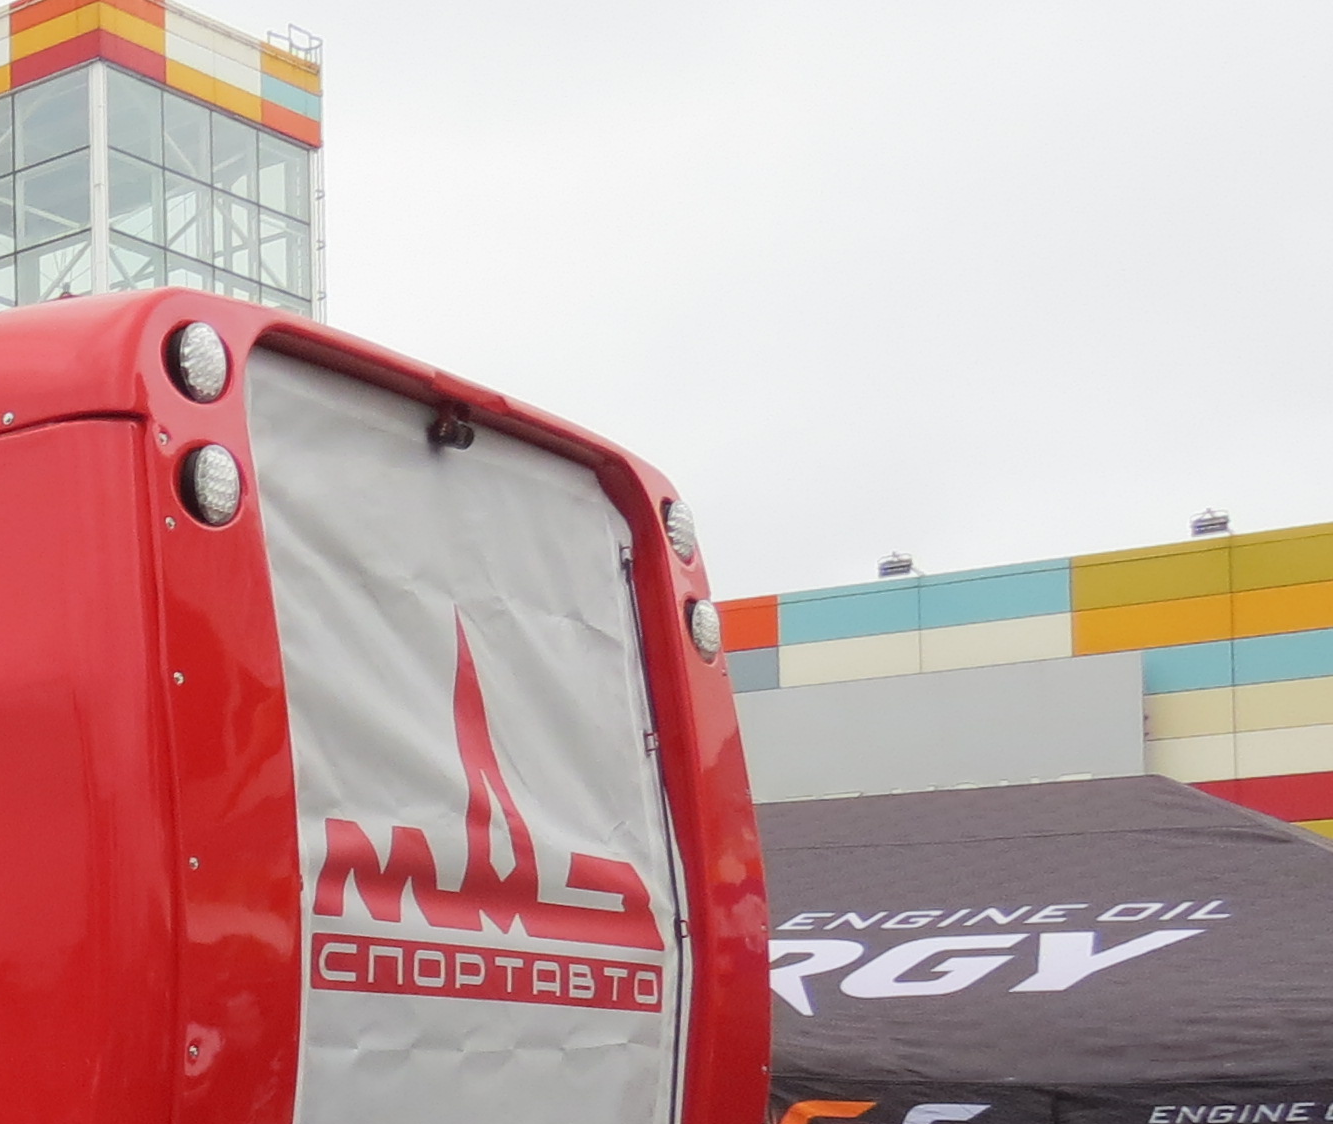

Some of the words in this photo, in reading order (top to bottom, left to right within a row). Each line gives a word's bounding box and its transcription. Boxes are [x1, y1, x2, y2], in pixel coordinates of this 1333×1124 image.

[775, 903, 1089, 931] ENGINE
[1096, 900, 1232, 921] OIL
[318, 941, 659, 1005] СПОРТАВТО
[1148, 1102, 1315, 1124] ENGINE
